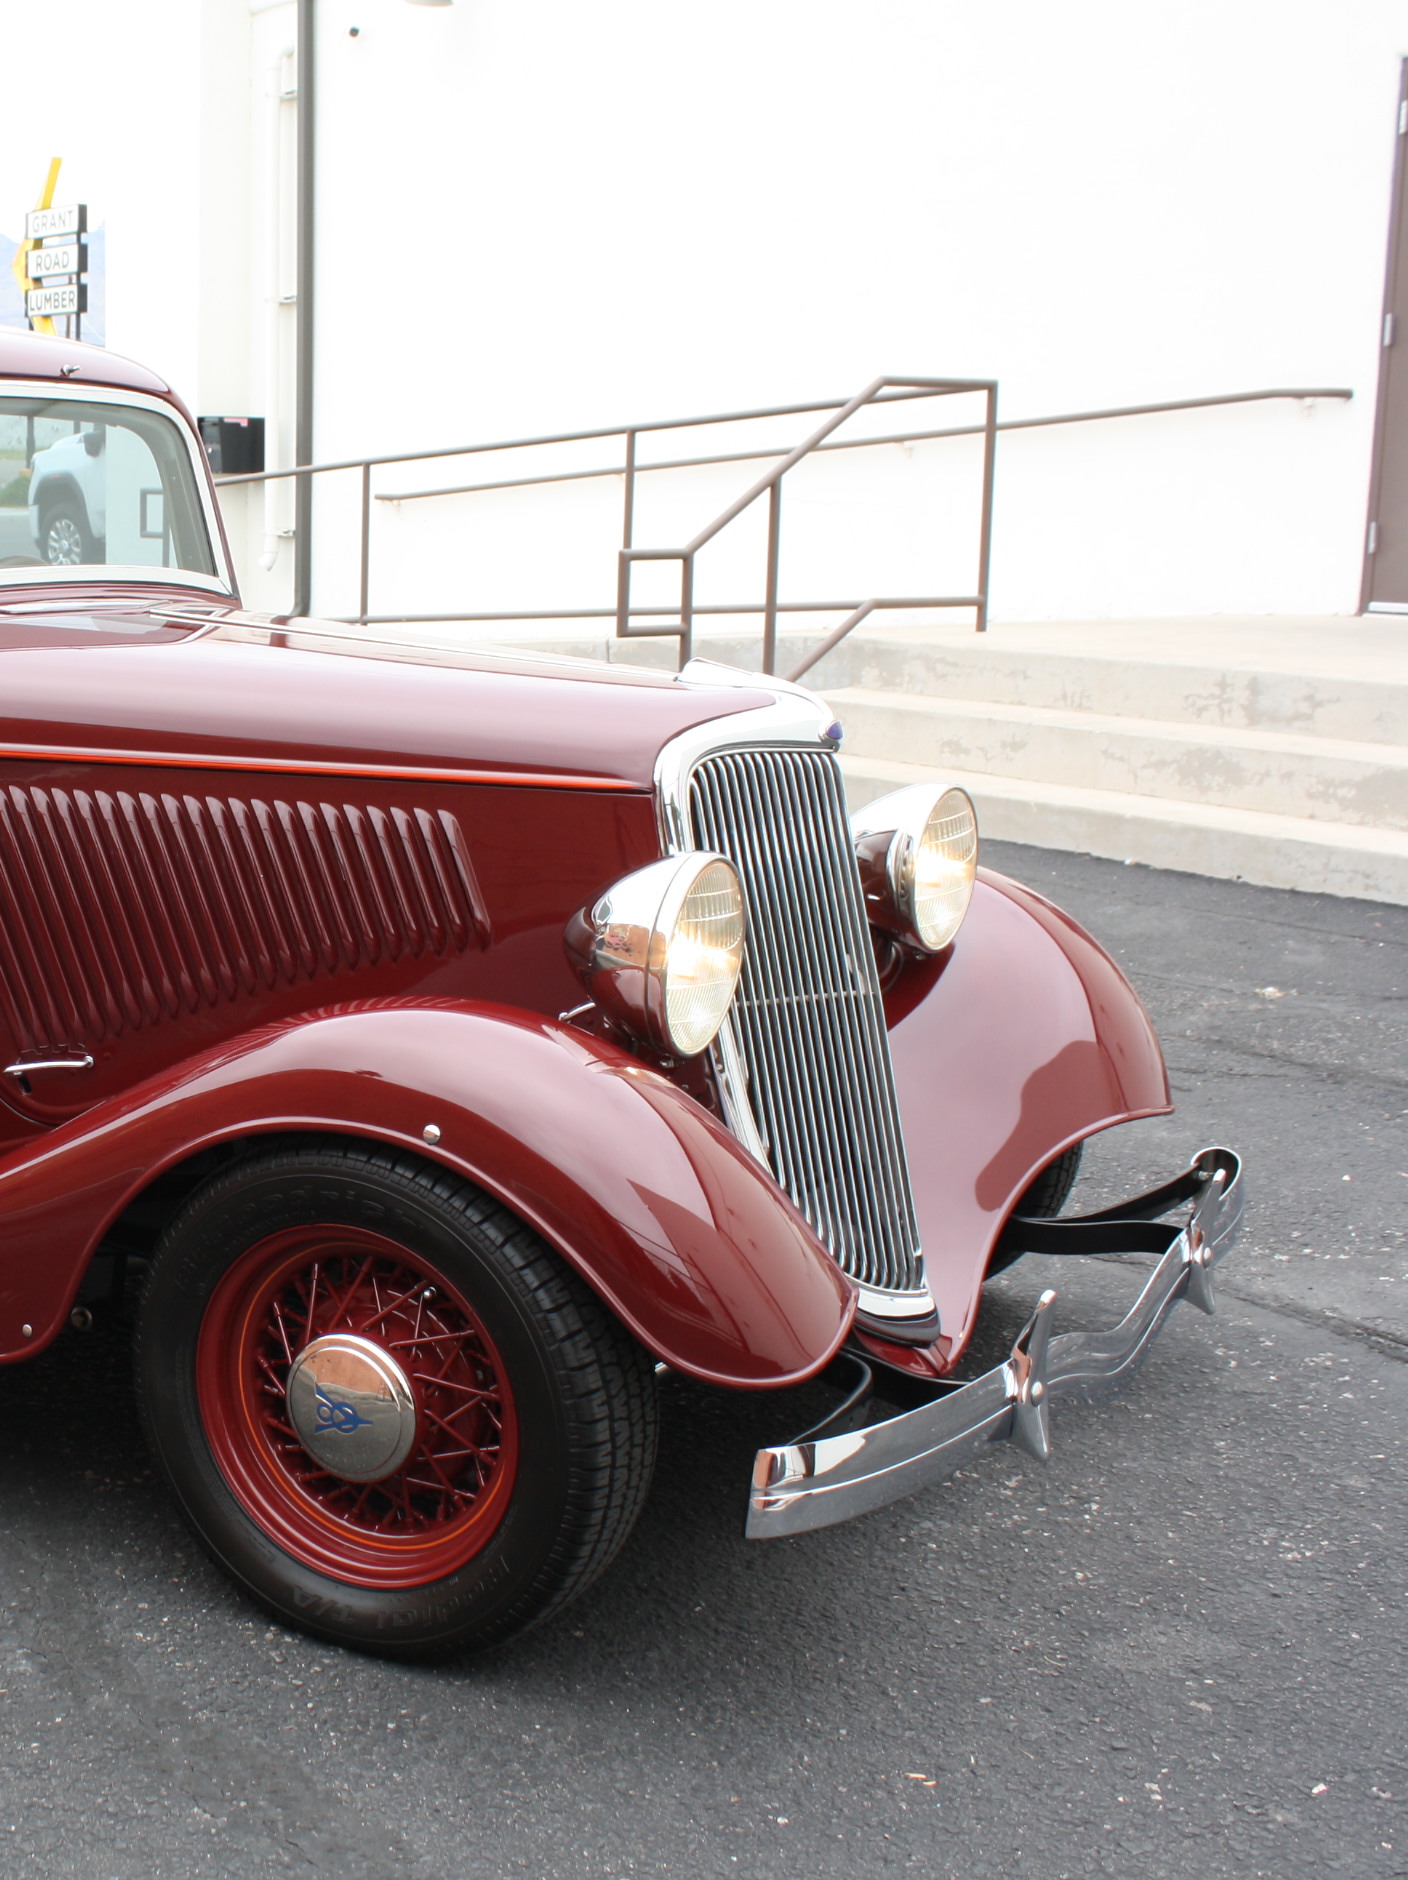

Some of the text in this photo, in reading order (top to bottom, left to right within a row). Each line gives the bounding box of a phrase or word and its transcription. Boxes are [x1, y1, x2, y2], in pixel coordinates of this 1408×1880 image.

[32, 209, 73, 233] GRANT
[35, 251, 70, 272] ROAD
[29, 291, 75, 311] LUMBER
